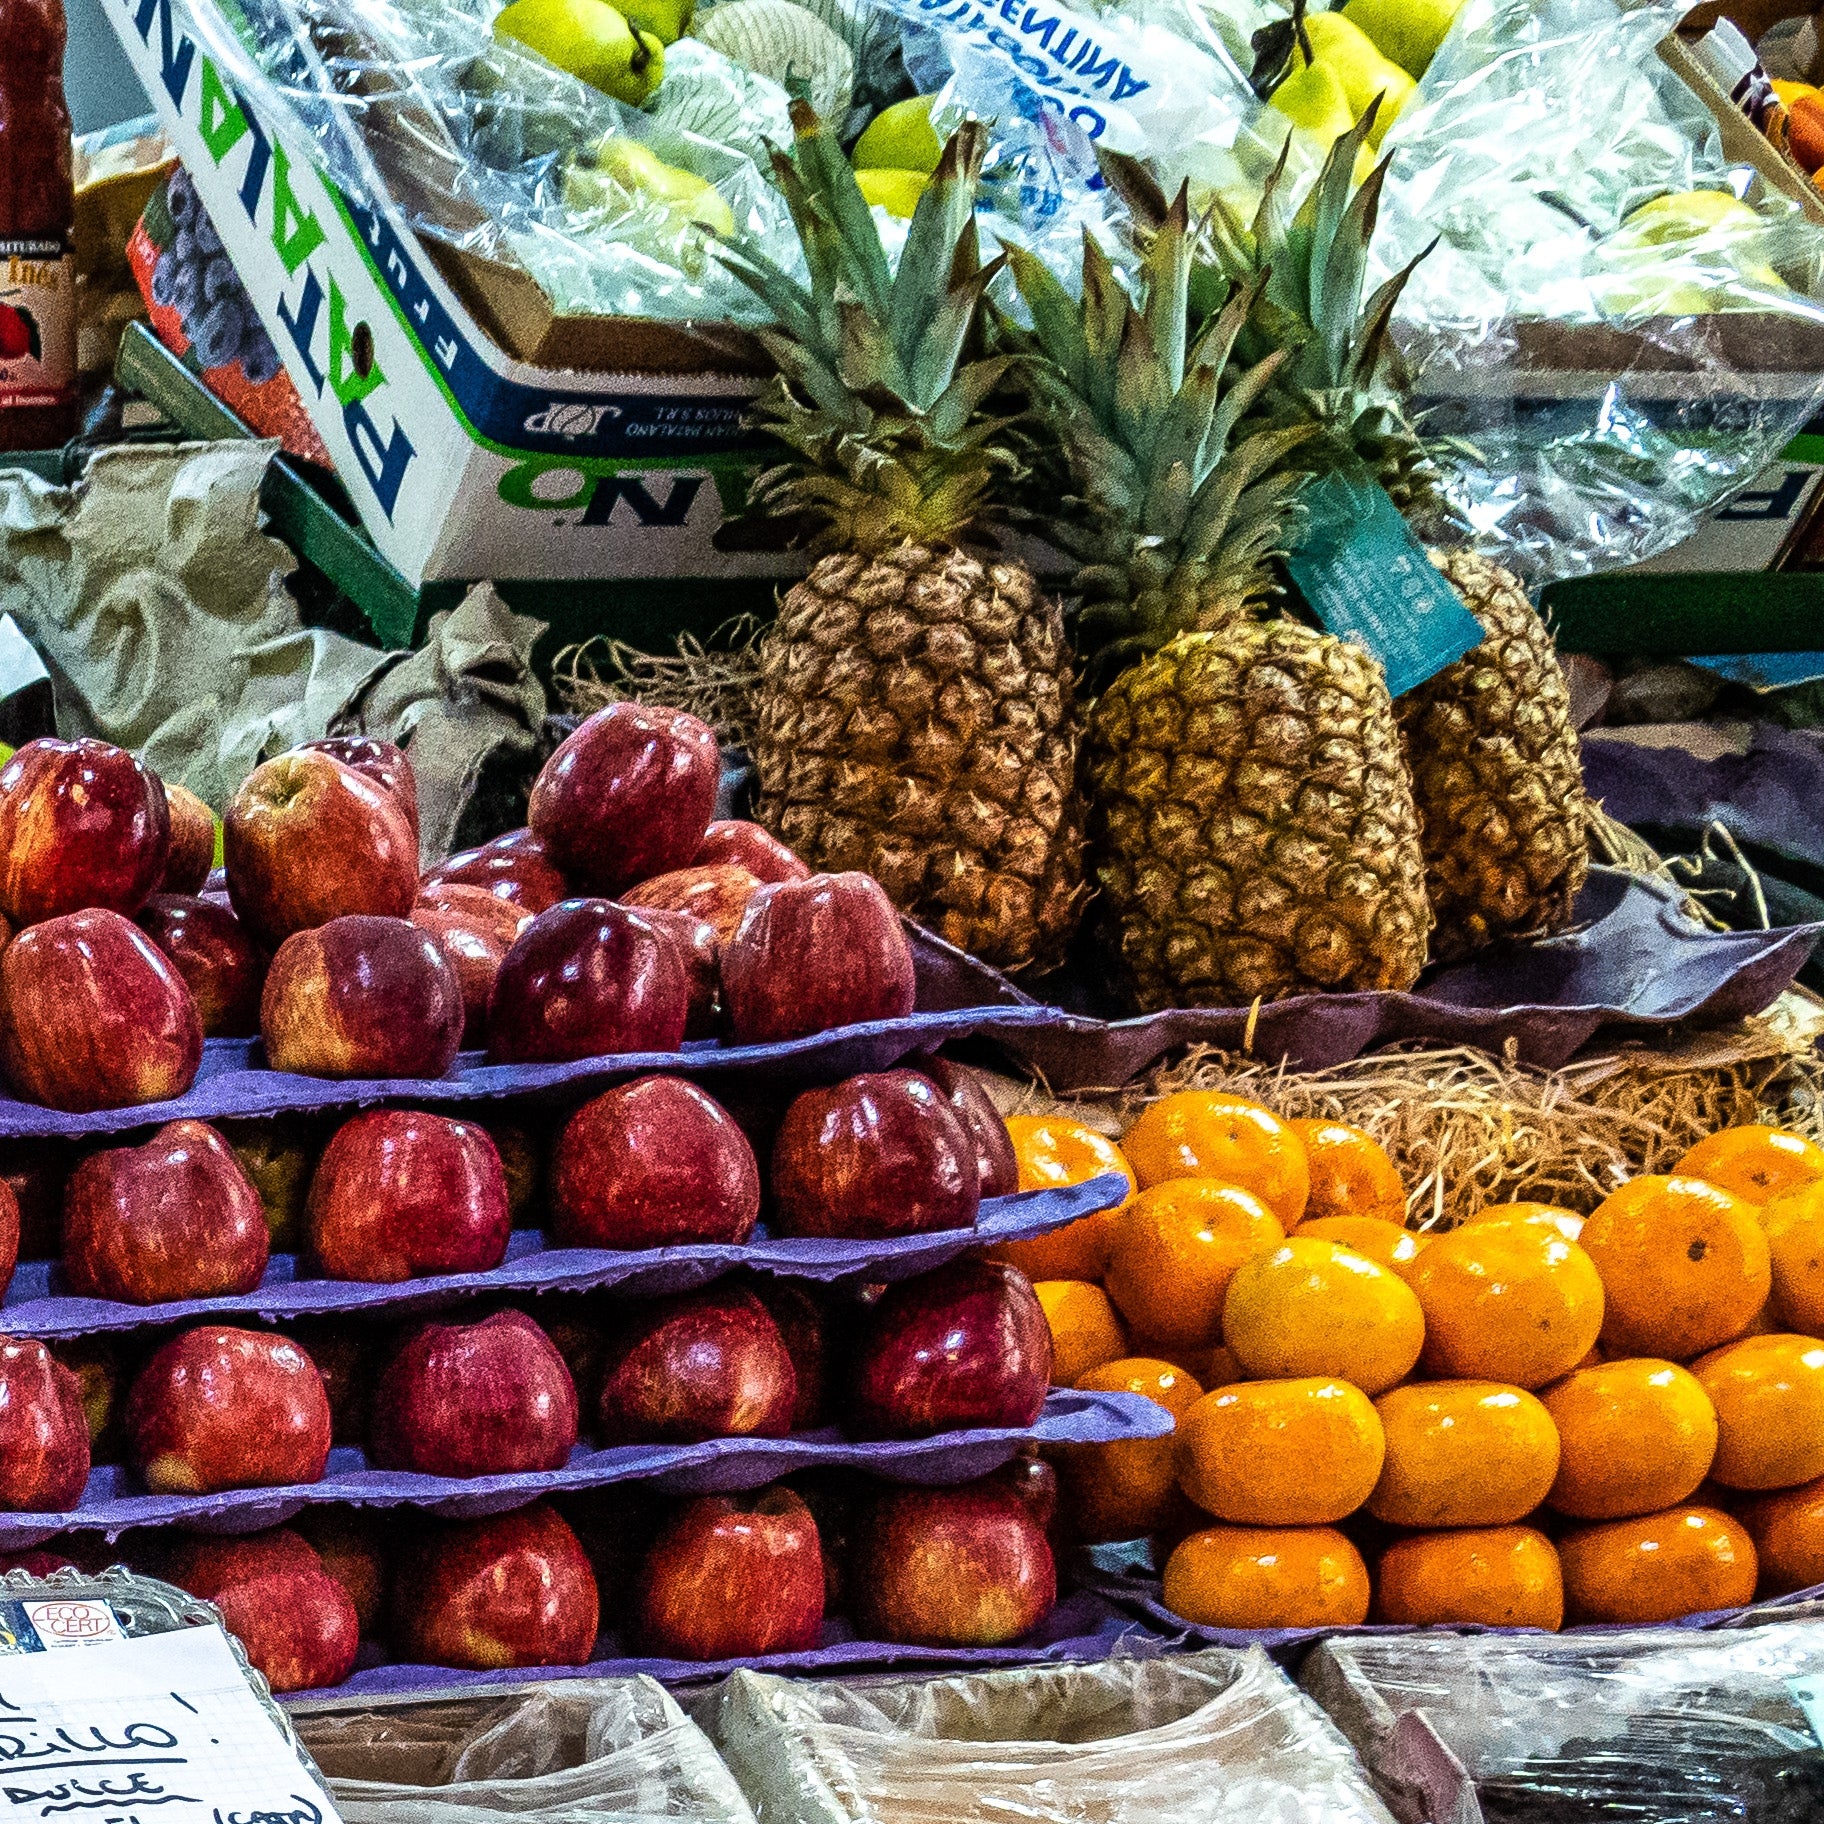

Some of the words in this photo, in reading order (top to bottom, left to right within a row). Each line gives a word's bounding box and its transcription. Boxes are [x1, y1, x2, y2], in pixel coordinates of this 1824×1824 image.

[44, 1604, 91, 1624] ECO
[50, 1615, 106, 1637] CERT
[4, 1772, 166, 1806] DULCE
